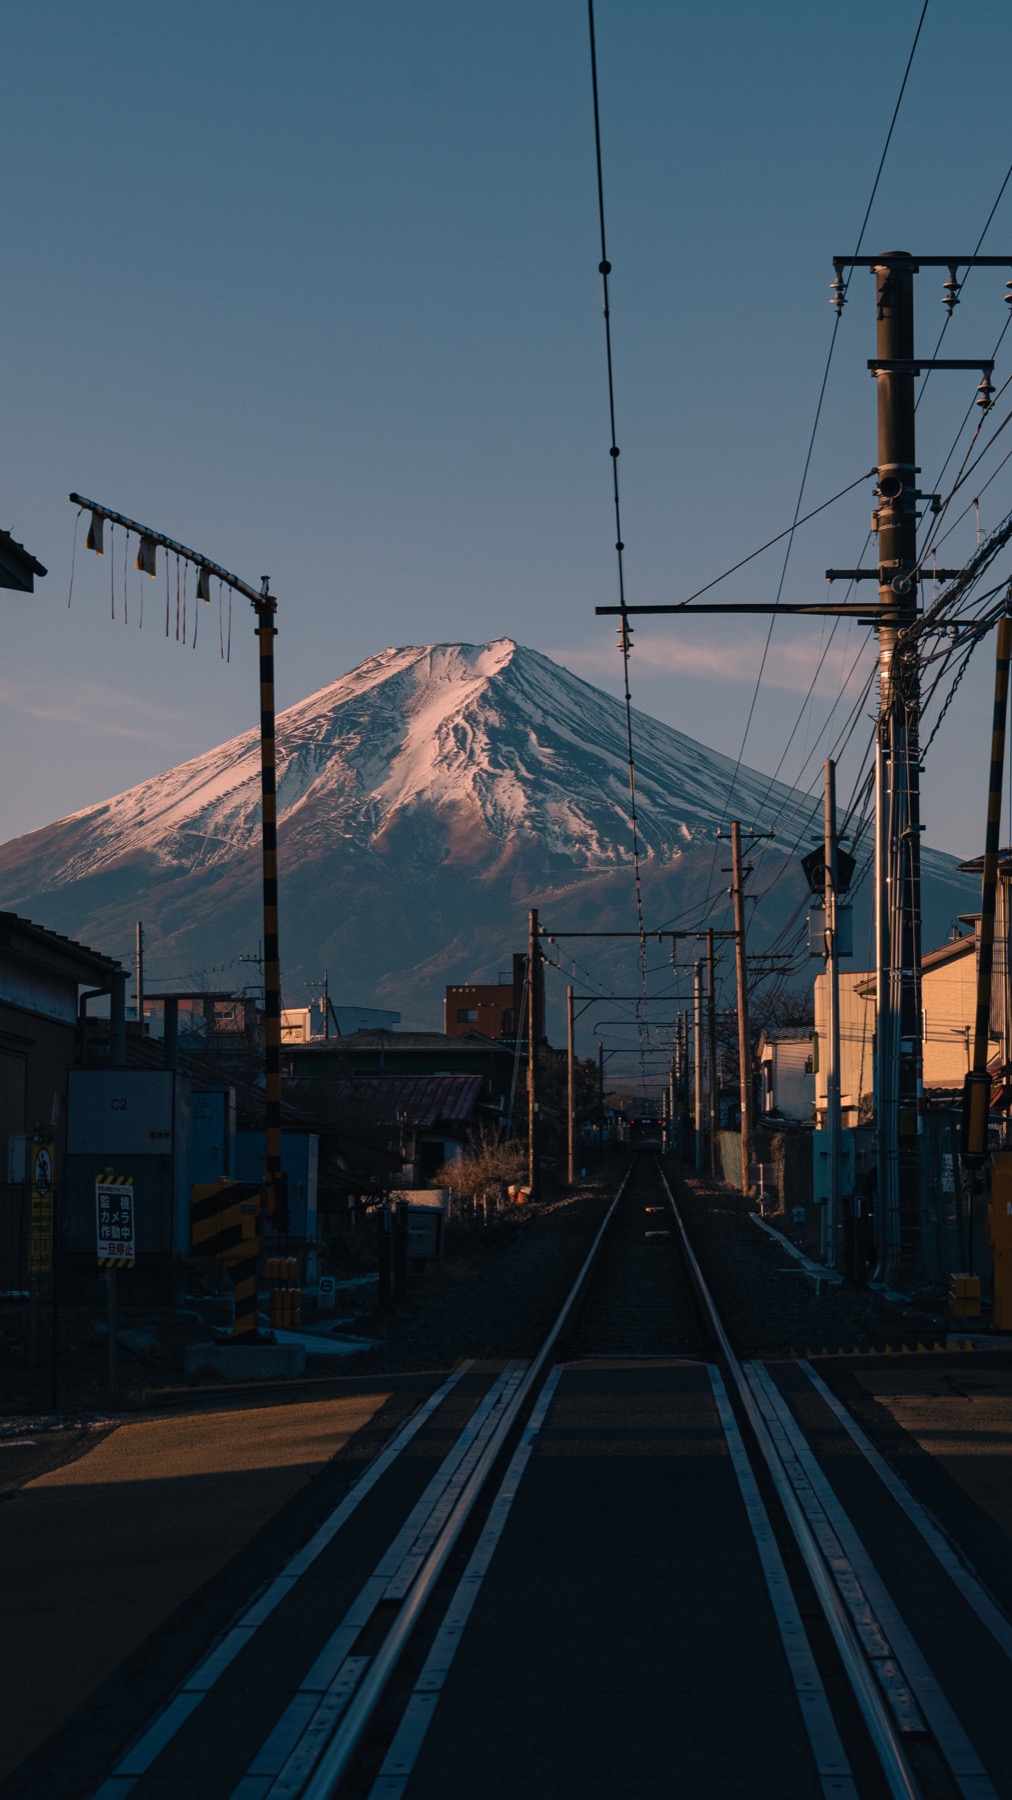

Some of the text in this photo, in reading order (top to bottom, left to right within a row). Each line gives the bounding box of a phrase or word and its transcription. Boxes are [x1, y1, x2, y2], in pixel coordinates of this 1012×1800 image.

[110, 1098, 127, 1110] C2
[100, 1195, 129, 1210] 監視
[101, 1210, 129, 1224] カメラ
[101, 1225, 130, 1239] 作動中
[99, 1243, 133, 1256] 一旦停止
[320, 1279, 334, 1292] 6
